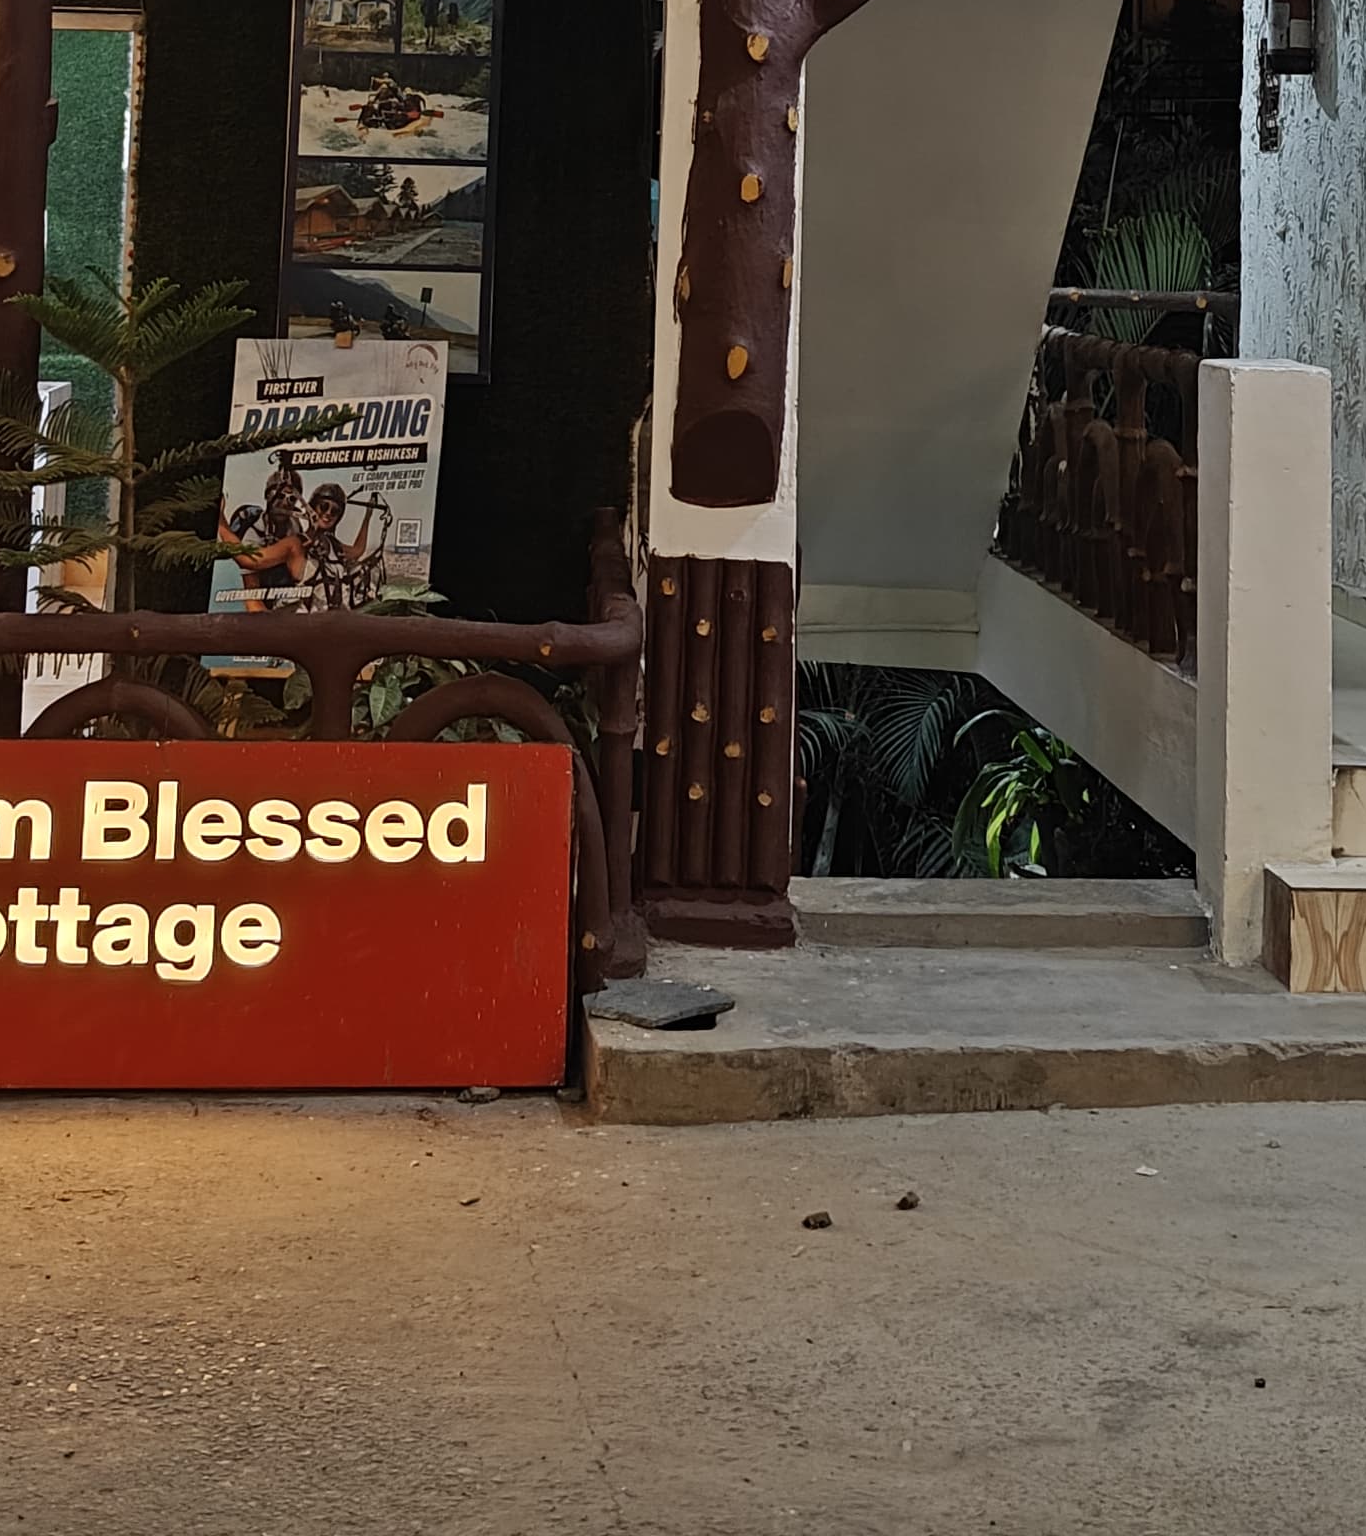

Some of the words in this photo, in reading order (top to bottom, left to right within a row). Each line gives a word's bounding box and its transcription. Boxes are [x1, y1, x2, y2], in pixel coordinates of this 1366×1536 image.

[263, 381, 291, 396] FIRST
[293, 380, 318, 394] EVER
[291, 449, 350, 464] EXPERIENCE
[352, 449, 364, 462] IN
[366, 447, 419, 462] RISHIKESH
[81, 781, 489, 863] Blessed
